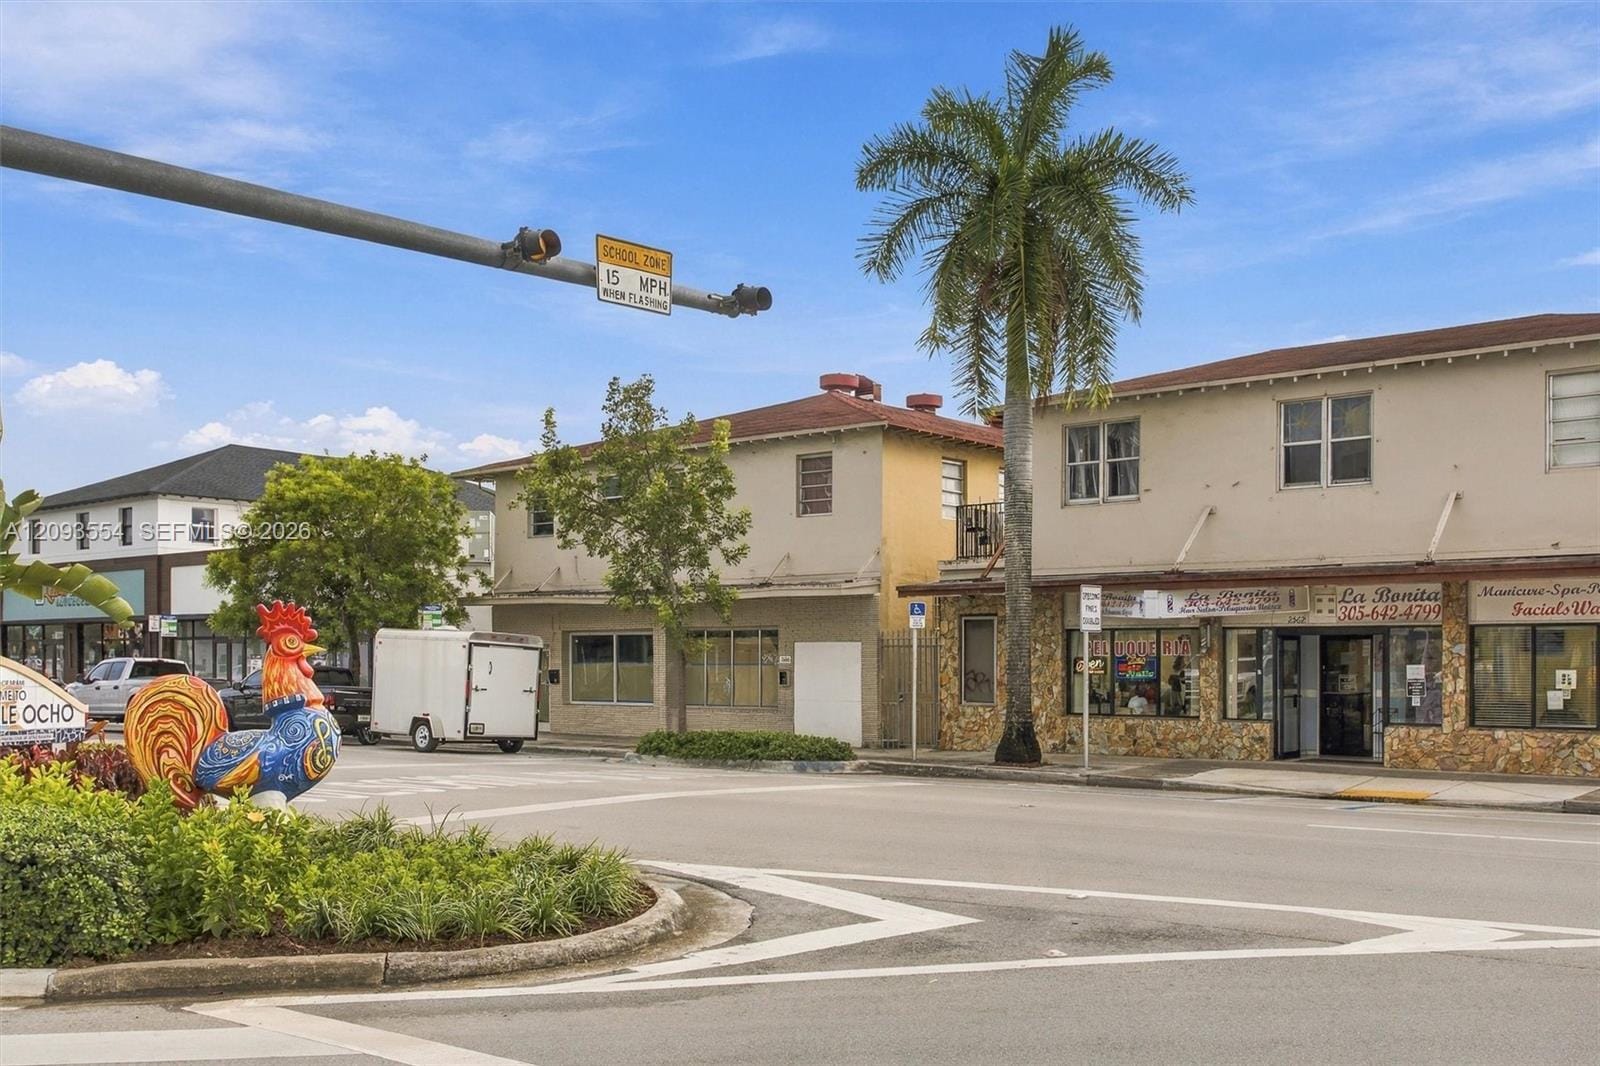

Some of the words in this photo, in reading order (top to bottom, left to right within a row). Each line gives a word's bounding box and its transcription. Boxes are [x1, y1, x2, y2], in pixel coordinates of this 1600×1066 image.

[602, 244, 640, 265] SCHOOL
[643, 254, 667, 271] ZONE
[606, 268, 620, 286] 15
[640, 275, 667, 297] MPH
[602, 287, 626, 300] WHEN
[628, 292, 668, 311] FLASHING
[1217, 589, 1280, 600] Bonita
[1338, 587, 1367, 604] La
[1372, 586, 1441, 604] Bonita
[1338, 603, 1442, 621] 305-642-4799
[1512, 601, 1570, 617] Facials
[1076, 658, 1105, 673] Oen
[22, 703, 74, 724] OCHO
